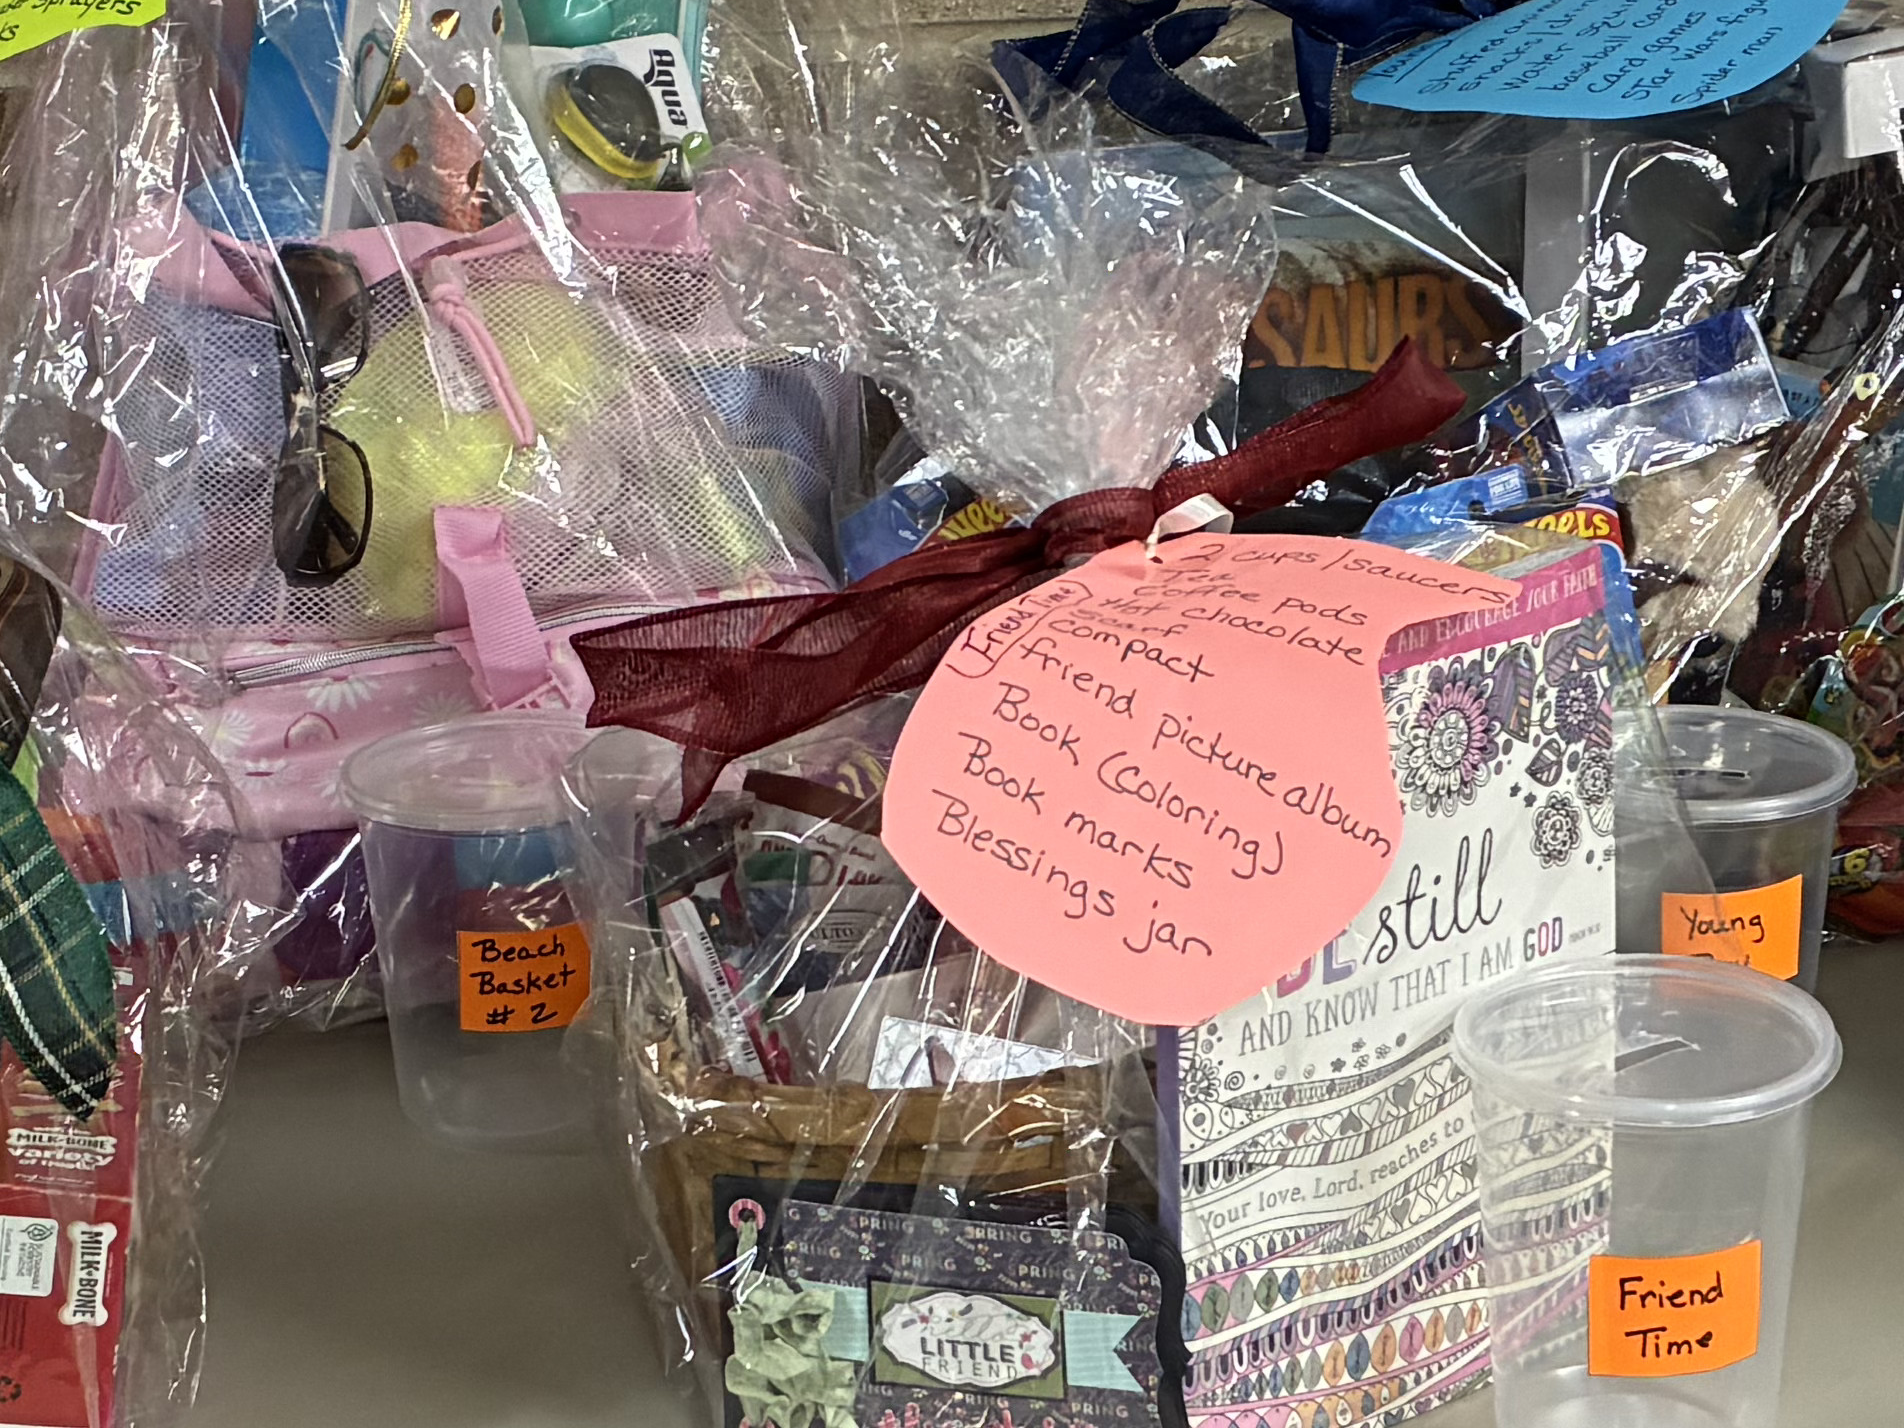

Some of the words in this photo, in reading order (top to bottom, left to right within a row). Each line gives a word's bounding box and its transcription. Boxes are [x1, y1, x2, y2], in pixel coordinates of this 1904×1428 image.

[1179, 543, 1226, 562] 2
[1180, 600, 1367, 670] chocolate
[1282, 596, 1368, 633] pods
[1046, 611, 1216, 680] compact
[984, 681, 1081, 767] Book
[1017, 635, 1137, 718] friend
[1151, 712, 1279, 790] picture
[1275, 786, 1392, 859] album
[957, 732, 1046, 816] Book
[1063, 811, 1194, 890] marks
[930, 790, 1118, 921] Blessings
[1122, 899, 1213, 957] jar
[1362, 826, 1503, 966] still
[471, 933, 566, 962] Beach
[1679, 905, 1765, 943] Young
[468, 961, 576, 995] Basket
[1236, 1000, 1295, 1058] AND
[1303, 981, 1382, 1043] KNOW
[1387, 960, 1453, 1015] THAT
[1460, 950, 1471, 990] I
[1475, 943, 1516, 987] AM
[1522, 914, 1565, 970] GOD
[1194, 1198, 1250, 1235] Your
[1368, 1123, 1444, 1185] reaches
[1442, 1115, 1465, 1145] to
[1618, 1269, 1724, 1311] Friend
[920, 1338, 1017, 1365] LITTLE
[920, 1355, 1017, 1380] FRIEND
[1623, 1325, 1713, 1358] Time
